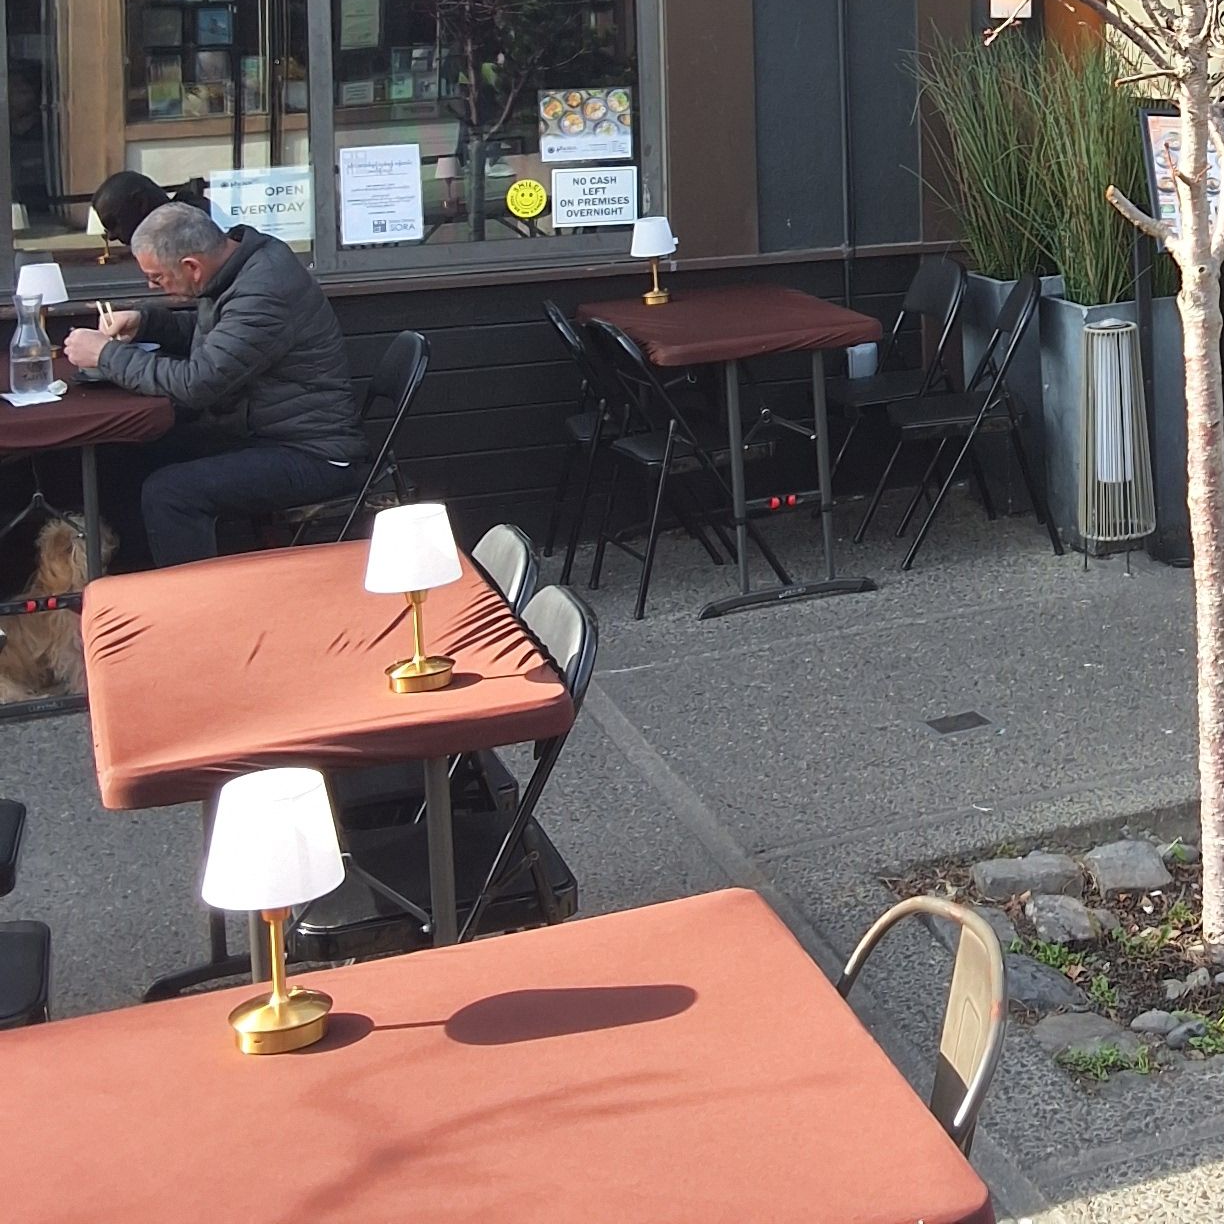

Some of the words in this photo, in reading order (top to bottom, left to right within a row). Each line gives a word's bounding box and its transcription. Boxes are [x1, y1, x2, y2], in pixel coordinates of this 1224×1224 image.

[572, 177, 587, 185] NO
[590, 176, 617, 185] CASH
[265, 185, 304, 197] OPEN
[582, 187, 607, 196] LEFT
[560, 199, 574, 208] ON
[577, 196, 630, 207] PREMISES
[231, 202, 305, 216] EVERYDAY
[566, 207, 624, 218] OVERNIGHT
